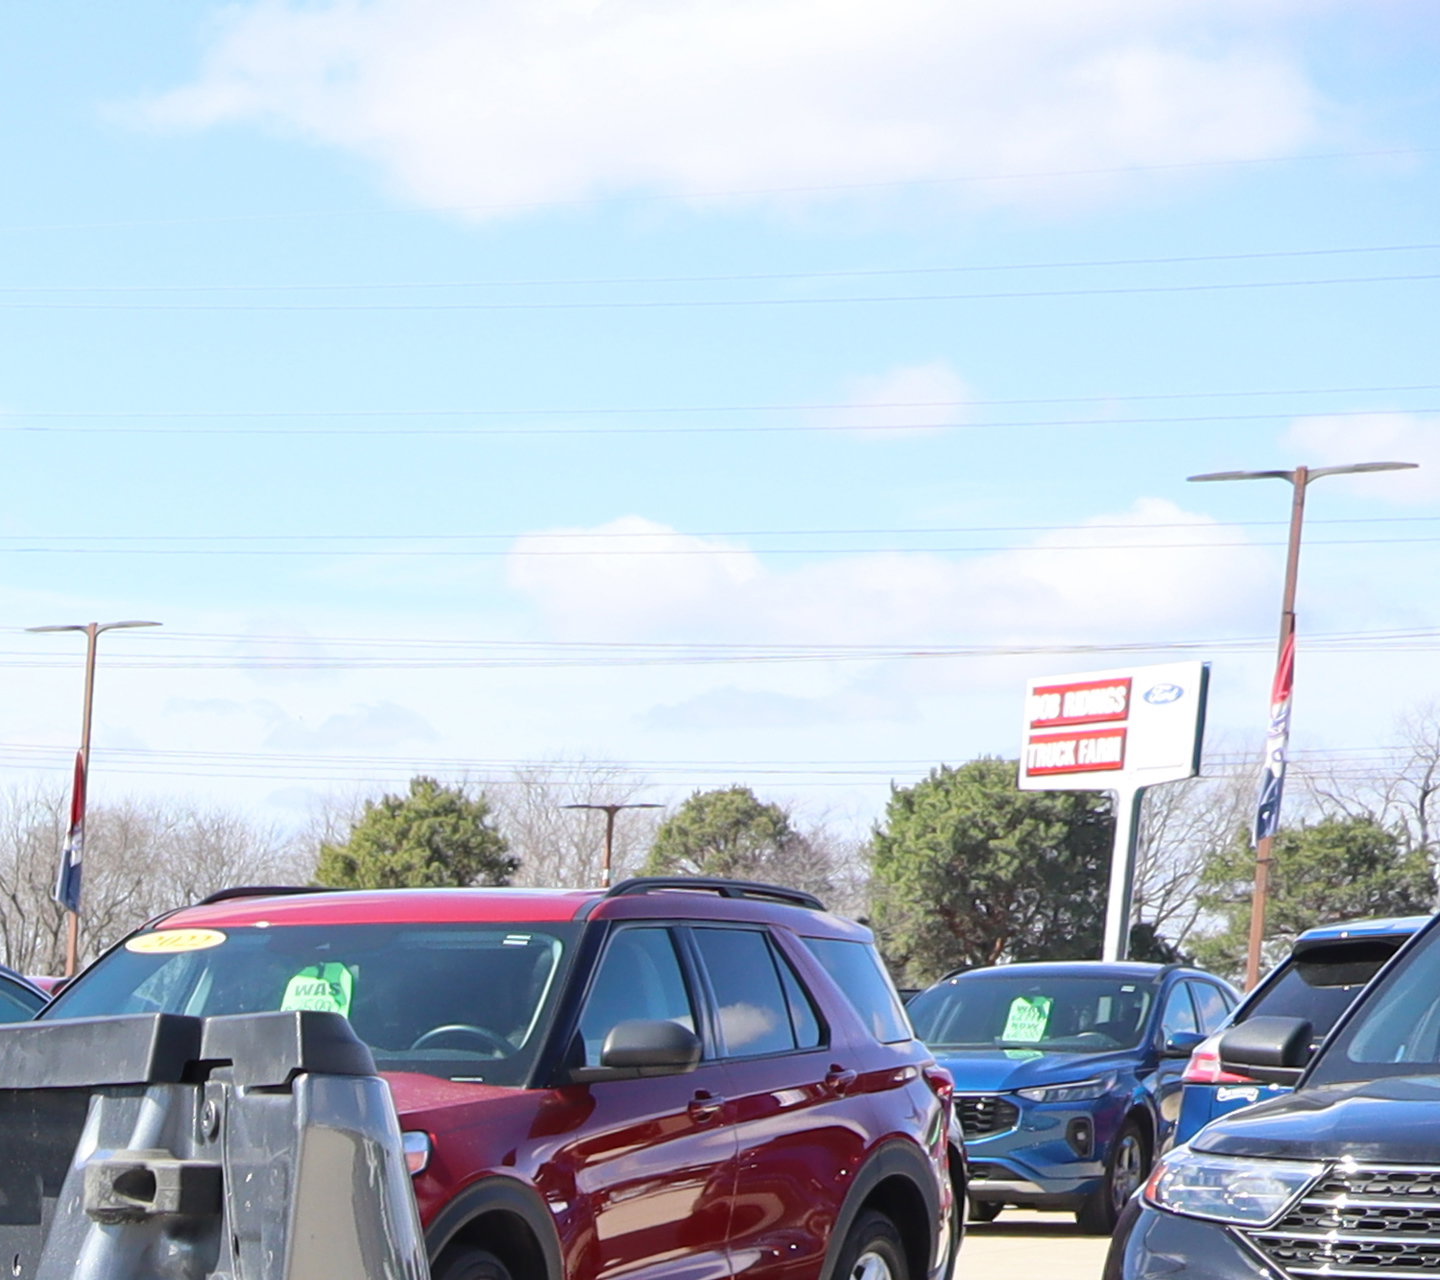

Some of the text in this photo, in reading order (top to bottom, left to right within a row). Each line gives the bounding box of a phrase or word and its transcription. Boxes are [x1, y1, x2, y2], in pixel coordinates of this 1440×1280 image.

[1146, 685, 1180, 703] Ford
[1027, 735, 1123, 769] TRUCK FARM
[295, 982, 341, 997] WAS
